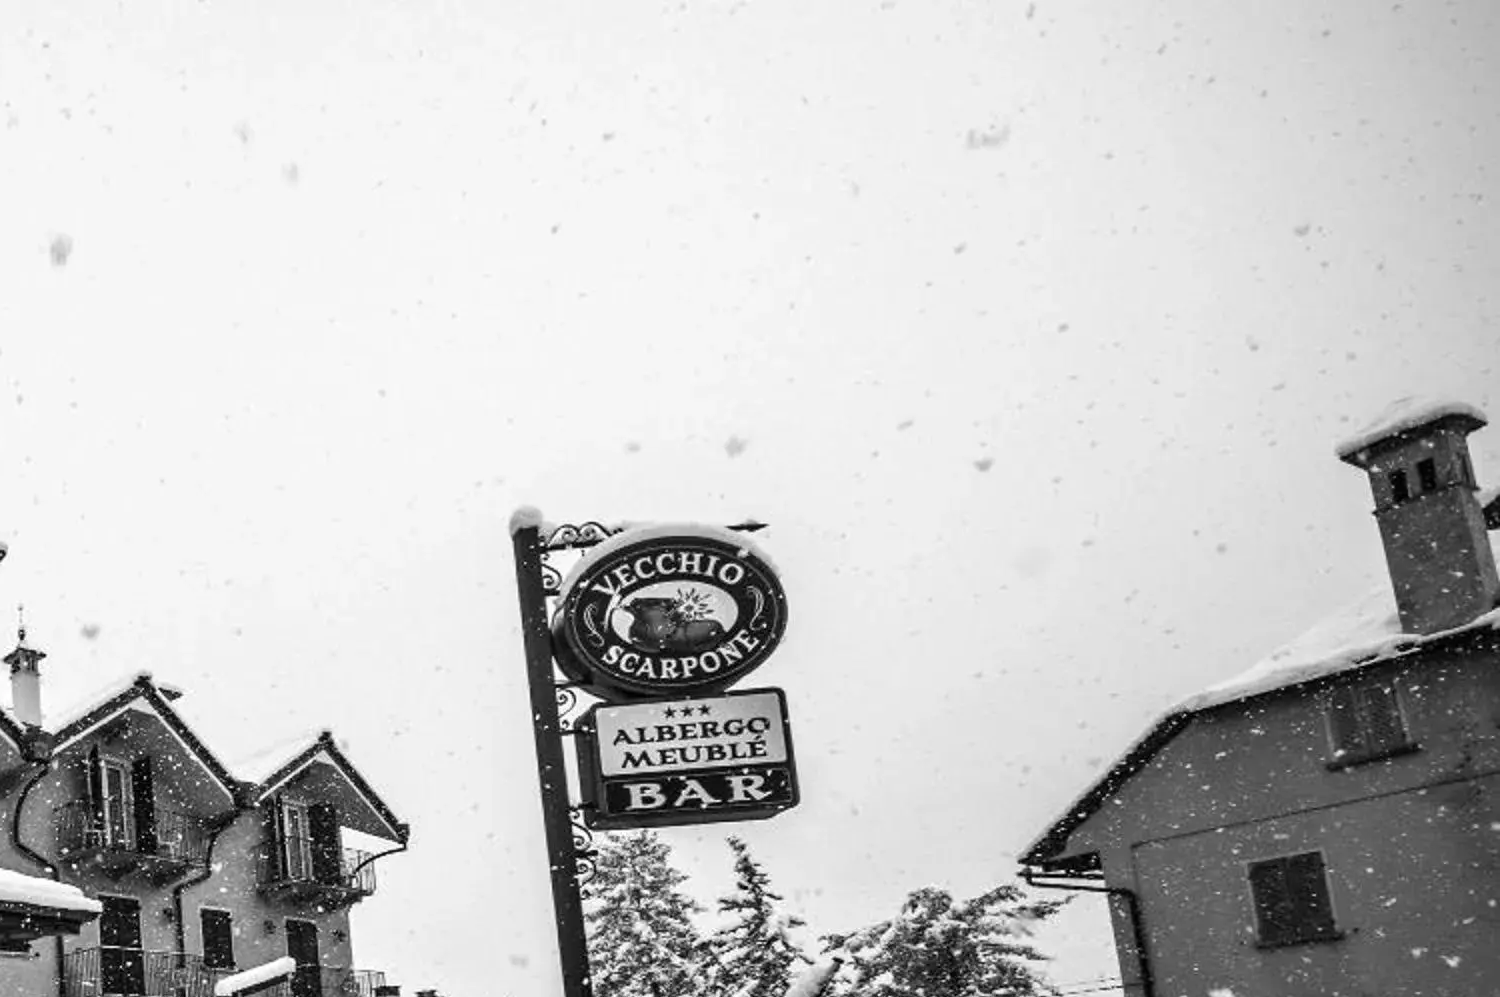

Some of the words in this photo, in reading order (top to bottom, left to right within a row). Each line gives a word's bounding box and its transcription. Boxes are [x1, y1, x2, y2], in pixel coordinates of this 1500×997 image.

[593, 551, 744, 597] VECCHIO
[602, 630, 760, 679] SCARPONE
[613, 717, 770, 746] ALBERGO
[621, 736, 767, 768] MEUBLÉ
[623, 775, 772, 810] BAR
